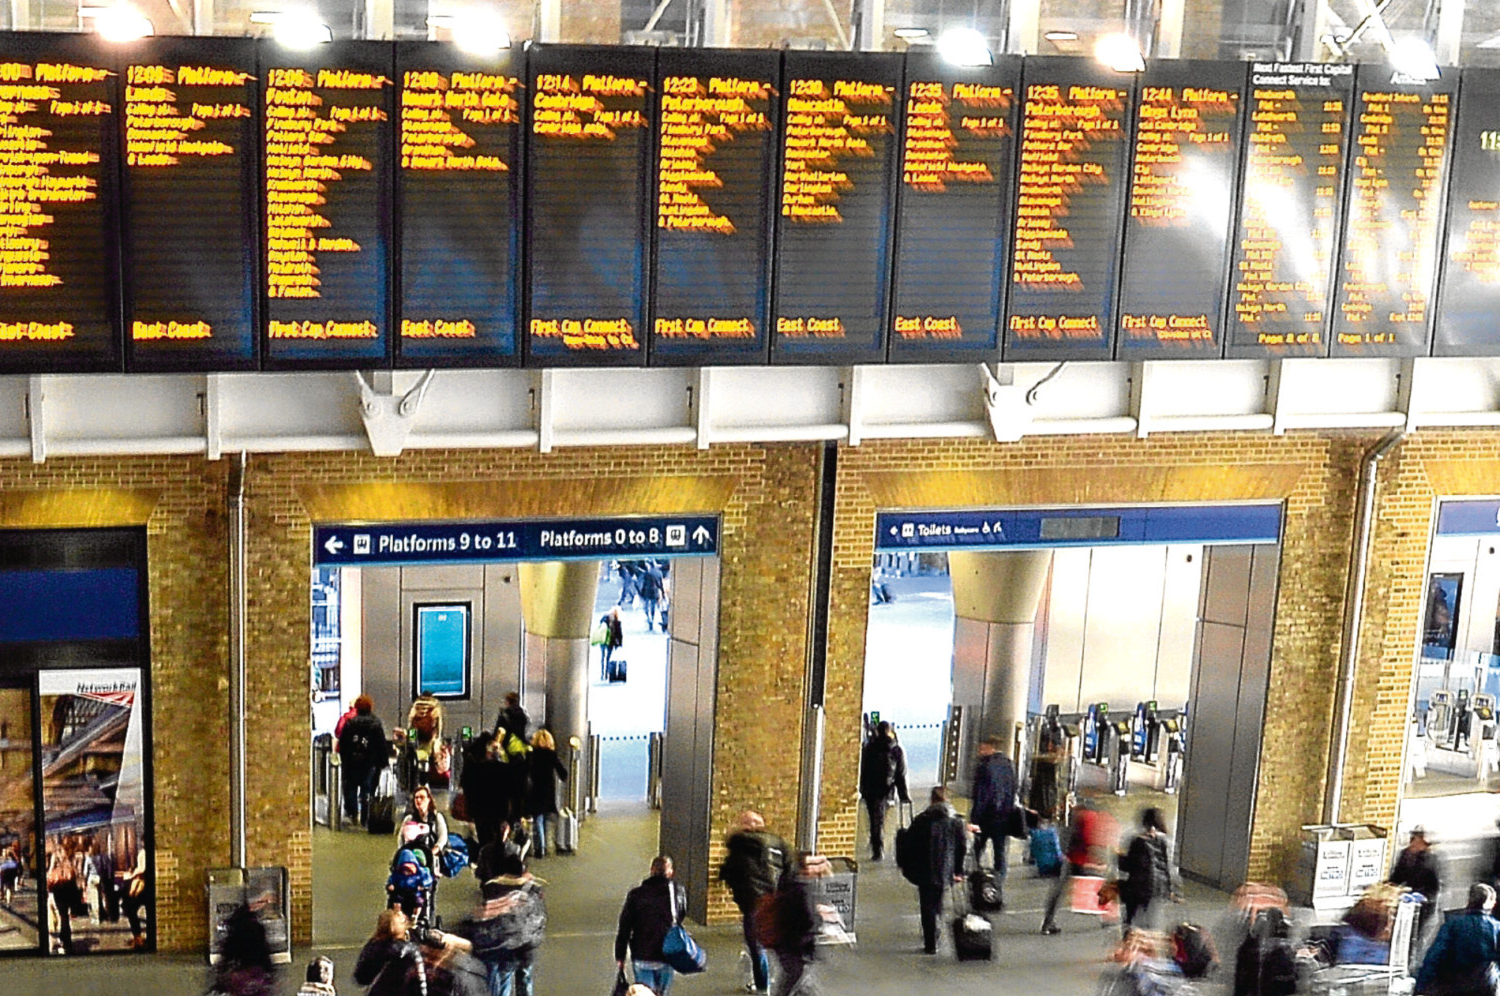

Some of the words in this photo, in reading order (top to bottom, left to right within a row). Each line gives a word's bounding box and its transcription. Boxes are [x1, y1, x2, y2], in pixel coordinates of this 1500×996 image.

[35, 63, 94, 82] Platform
[178, 66, 235, 86] Platform
[317, 69, 373, 88] Platform
[451, 72, 505, 89] Platform
[582, 75, 635, 91] Platform
[709, 77, 759, 93] Platform
[834, 80, 883, 96] Platform
[953, 83, 1001, 98] Platform
[1069, 86, 1116, 99] Platform
[1182, 88, 1228, 102] Platform
[662, 95, 744, 111] Peterborough
[787, 97, 845, 112] Newcastle
[907, 99, 943, 113] Leeds
[1025, 102, 1100, 119] Peterborough
[1139, 104, 1167, 119] Kings
[1170, 105, 1197, 119] Lynn
[1155, 121, 1197, 132] Cambridge
[401, 320, 428, 336] East
[434, 320, 470, 336] Coast
[530, 318, 558, 334] First
[561, 318, 581, 334] Cap
[584, 318, 626, 333] Connect
[655, 318, 683, 334] First
[685, 318, 705, 334] Cap
[707, 318, 749, 333] Connect
[777, 317, 803, 332] East
[807, 317, 840, 332] Coast
[895, 315, 921, 331] East
[924, 315, 956, 331] Coast
[1010, 315, 1035, 329] First
[1038, 316, 1056, 331] Cap
[1058, 315, 1096, 329] Connect
[1122, 314, 1146, 328] First
[1149, 314, 1167, 328] Cap
[1169, 314, 1206, 328] Connect
[28, 321, 66, 340] Coast
[133, 321, 162, 339] East
[168, 320, 203, 339] Coast
[269, 320, 297, 339] First
[301, 320, 324, 339] Cap
[325, 320, 371, 338] Connect
[1258, 333, 1284, 345] Page
[1338, 333, 1362, 345] Page
[541, 530, 612, 547] Platforms
[615, 529, 625, 544] 0
[629, 529, 646, 545] to
[649, 528, 659, 544] 8
[918, 523, 951, 536] Toilets
[379, 535, 456, 553] Platforms
[460, 534, 471, 549] 9
[474, 534, 492, 550] to
[496, 532, 517, 549] 11
